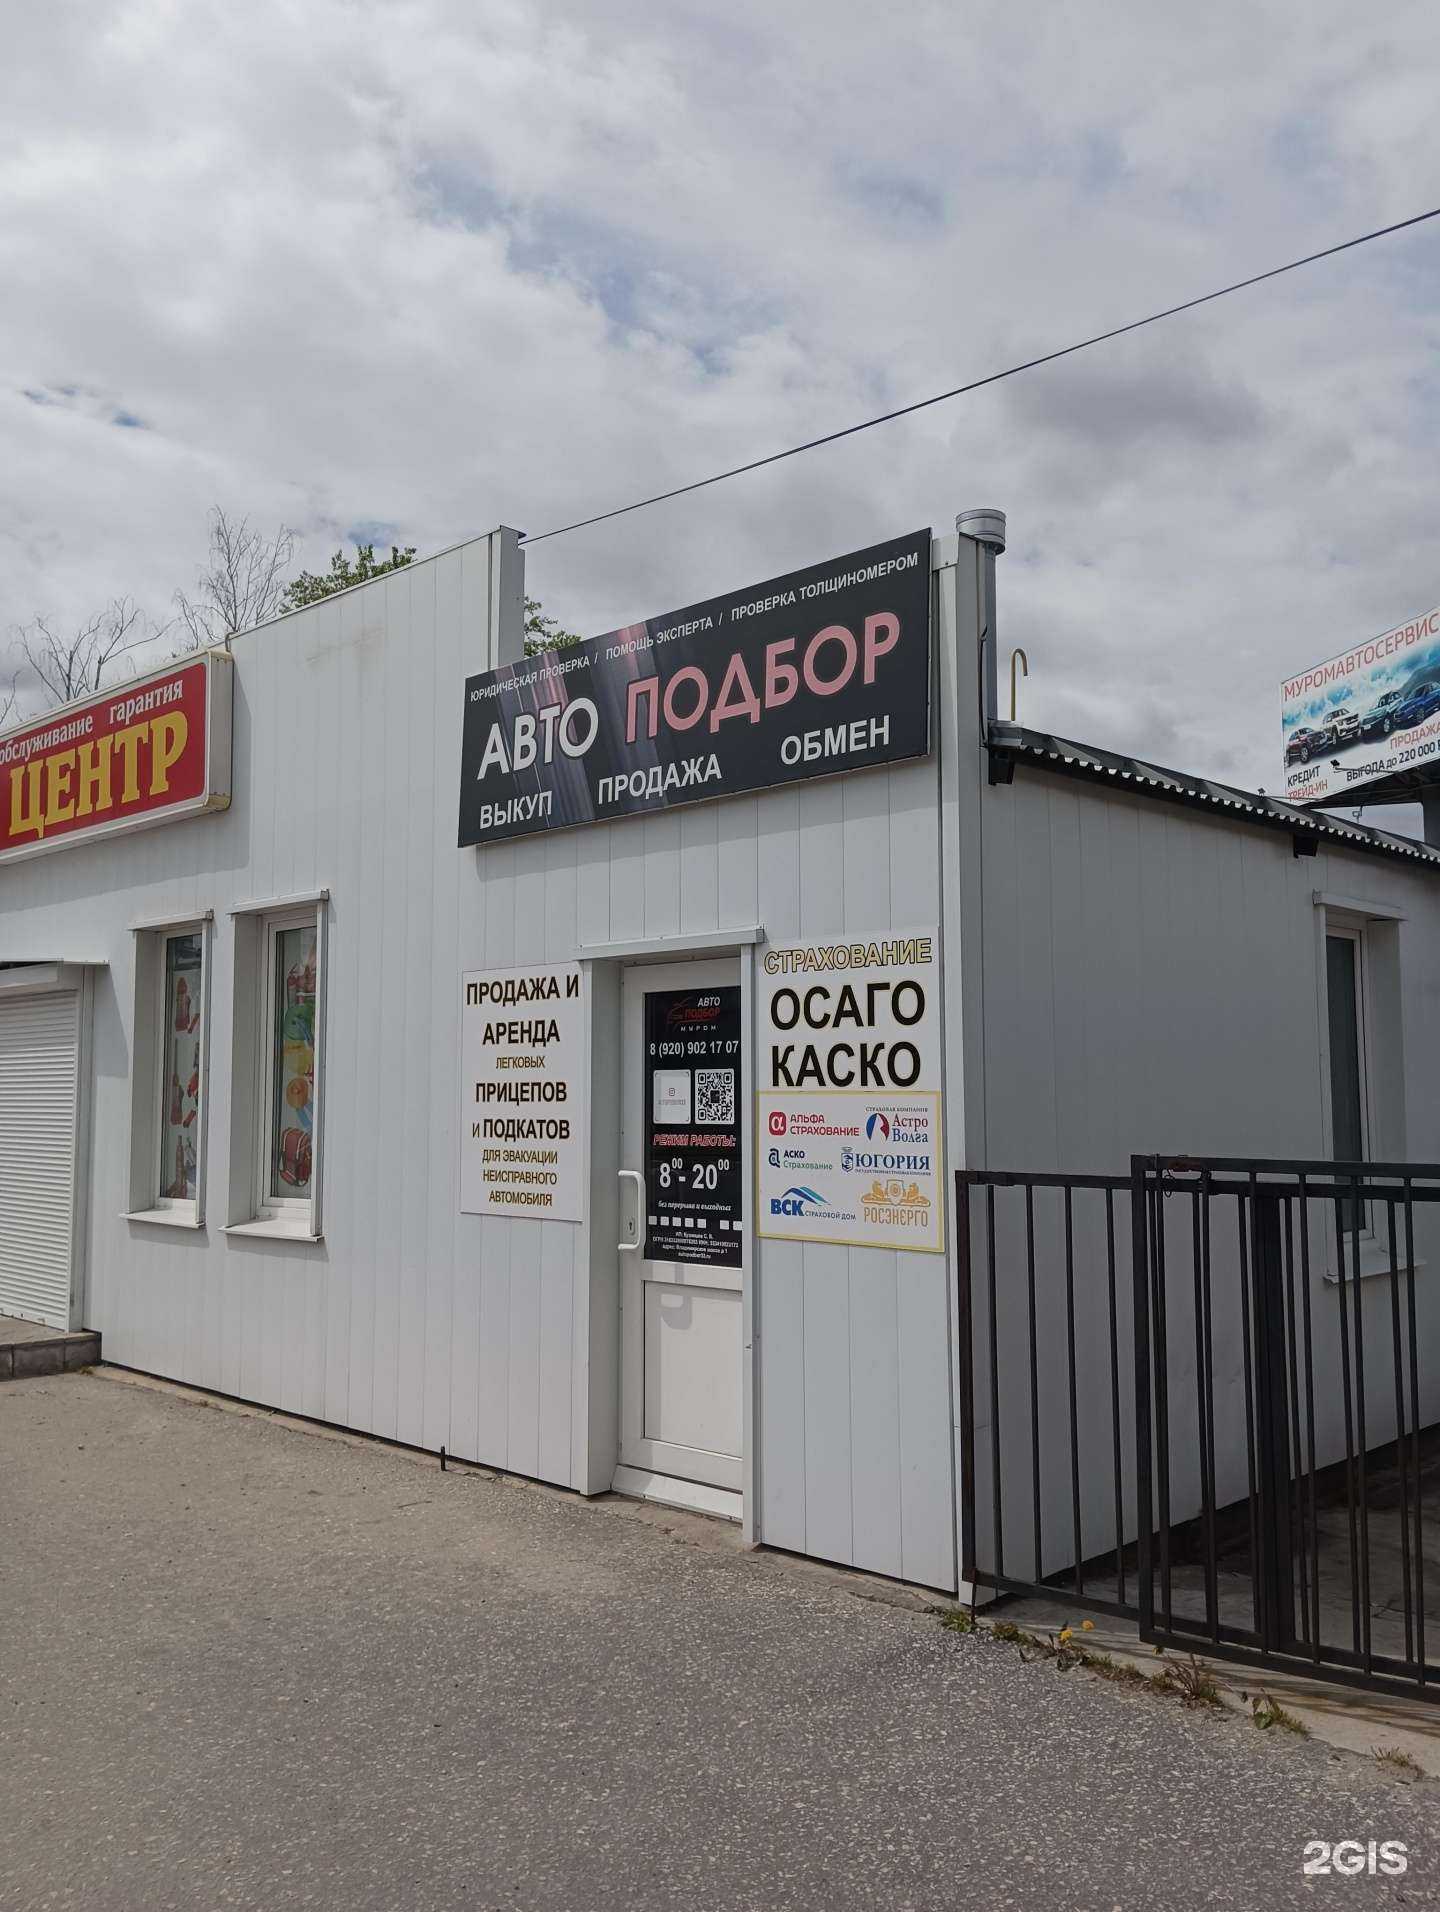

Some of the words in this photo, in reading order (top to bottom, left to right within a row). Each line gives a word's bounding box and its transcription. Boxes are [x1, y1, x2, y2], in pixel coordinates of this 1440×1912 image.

[470, 672, 537, 702] ЮРИДИЧЕСКАЯ
[540, 655, 590, 681] ПРОВЕРКА
[605, 637, 653, 660] ПОМОЩЬ
[656, 616, 713, 644] ЭКСПЕРТА
[731, 591, 796, 621] ПРОВЕРКА
[799, 552, 919, 600] ТОЛЩИНОМЕРОМ
[1284, 612, 1439, 702] МУРОМАВТОСЕРВИС
[476, 696, 599, 781] АВТО
[625, 611, 901, 744] ПОДБОР
[0, 715, 93, 766] обслуживание
[109, 679, 184, 725] гарантия
[479, 789, 553, 830] ВЫКУП
[597, 753, 722, 805] ПРОДАЖА
[780, 714, 890, 767] ОБМЕН
[1346, 759, 1385, 781] ВЫГОДА
[1399, 748, 1416, 764] 220
[1418, 741, 1436, 757] 000
[9, 710, 188, 839] ЦЕНТР
[1287, 765, 1320, 787] КРЕДИТ
[1288, 778, 1328, 802] ТРЕЙД-ИН
[764, 937, 933, 975] СТРАХОВАНИЕ
[466, 976, 560, 1007] ПРОДАЖА
[566, 974, 579, 999] И
[697, 996, 721, 1008] АВТО
[770, 980, 926, 1031] ОСАГО
[482, 1019, 561, 1048] АРЕНДА
[649, 1043, 656, 1056] 8
[659, 1042, 685, 1058] (920)
[687, 1041, 707, 1055] 902
[710, 1040, 723, 1054] 17
[725, 1040, 739, 1054] 07
[496, 1055, 545, 1070] ЛЕГКОВЫХ
[772, 1041, 921, 1087] КАСКО
[475, 1081, 567, 1106] ПРИЦЕПОВ
[483, 1118, 570, 1142] ПОДКАТОВ
[790, 1114, 825, 1124] АЛЬФА
[892, 1113, 929, 1132] Астро
[653, 1134, 689, 1146] РЕЖИМ
[790, 1126, 860, 1137] СТРАХОВАНИЕ
[892, 1128, 929, 1143] Волга
[482, 1149, 501, 1164] ДЛЯ
[503, 1149, 558, 1166] ЭВАКУАЦИИ
[783, 1150, 805, 1159] АСКО
[783, 1160, 833, 1171] Страхование
[855, 1153, 930, 1171] ЮГОРИЯ
[482, 1170, 558, 1185] НЕИСПРАВНОГО
[489, 1190, 553, 1207] АВТОМОБИЛЯ
[770, 1198, 805, 1217] ВСК
[805, 1210, 841, 1220] СТРАХОВОЙ
[841, 1213, 856, 1221] ДОМ
[863, 1207, 929, 1228] РОСЭНЕРГО
